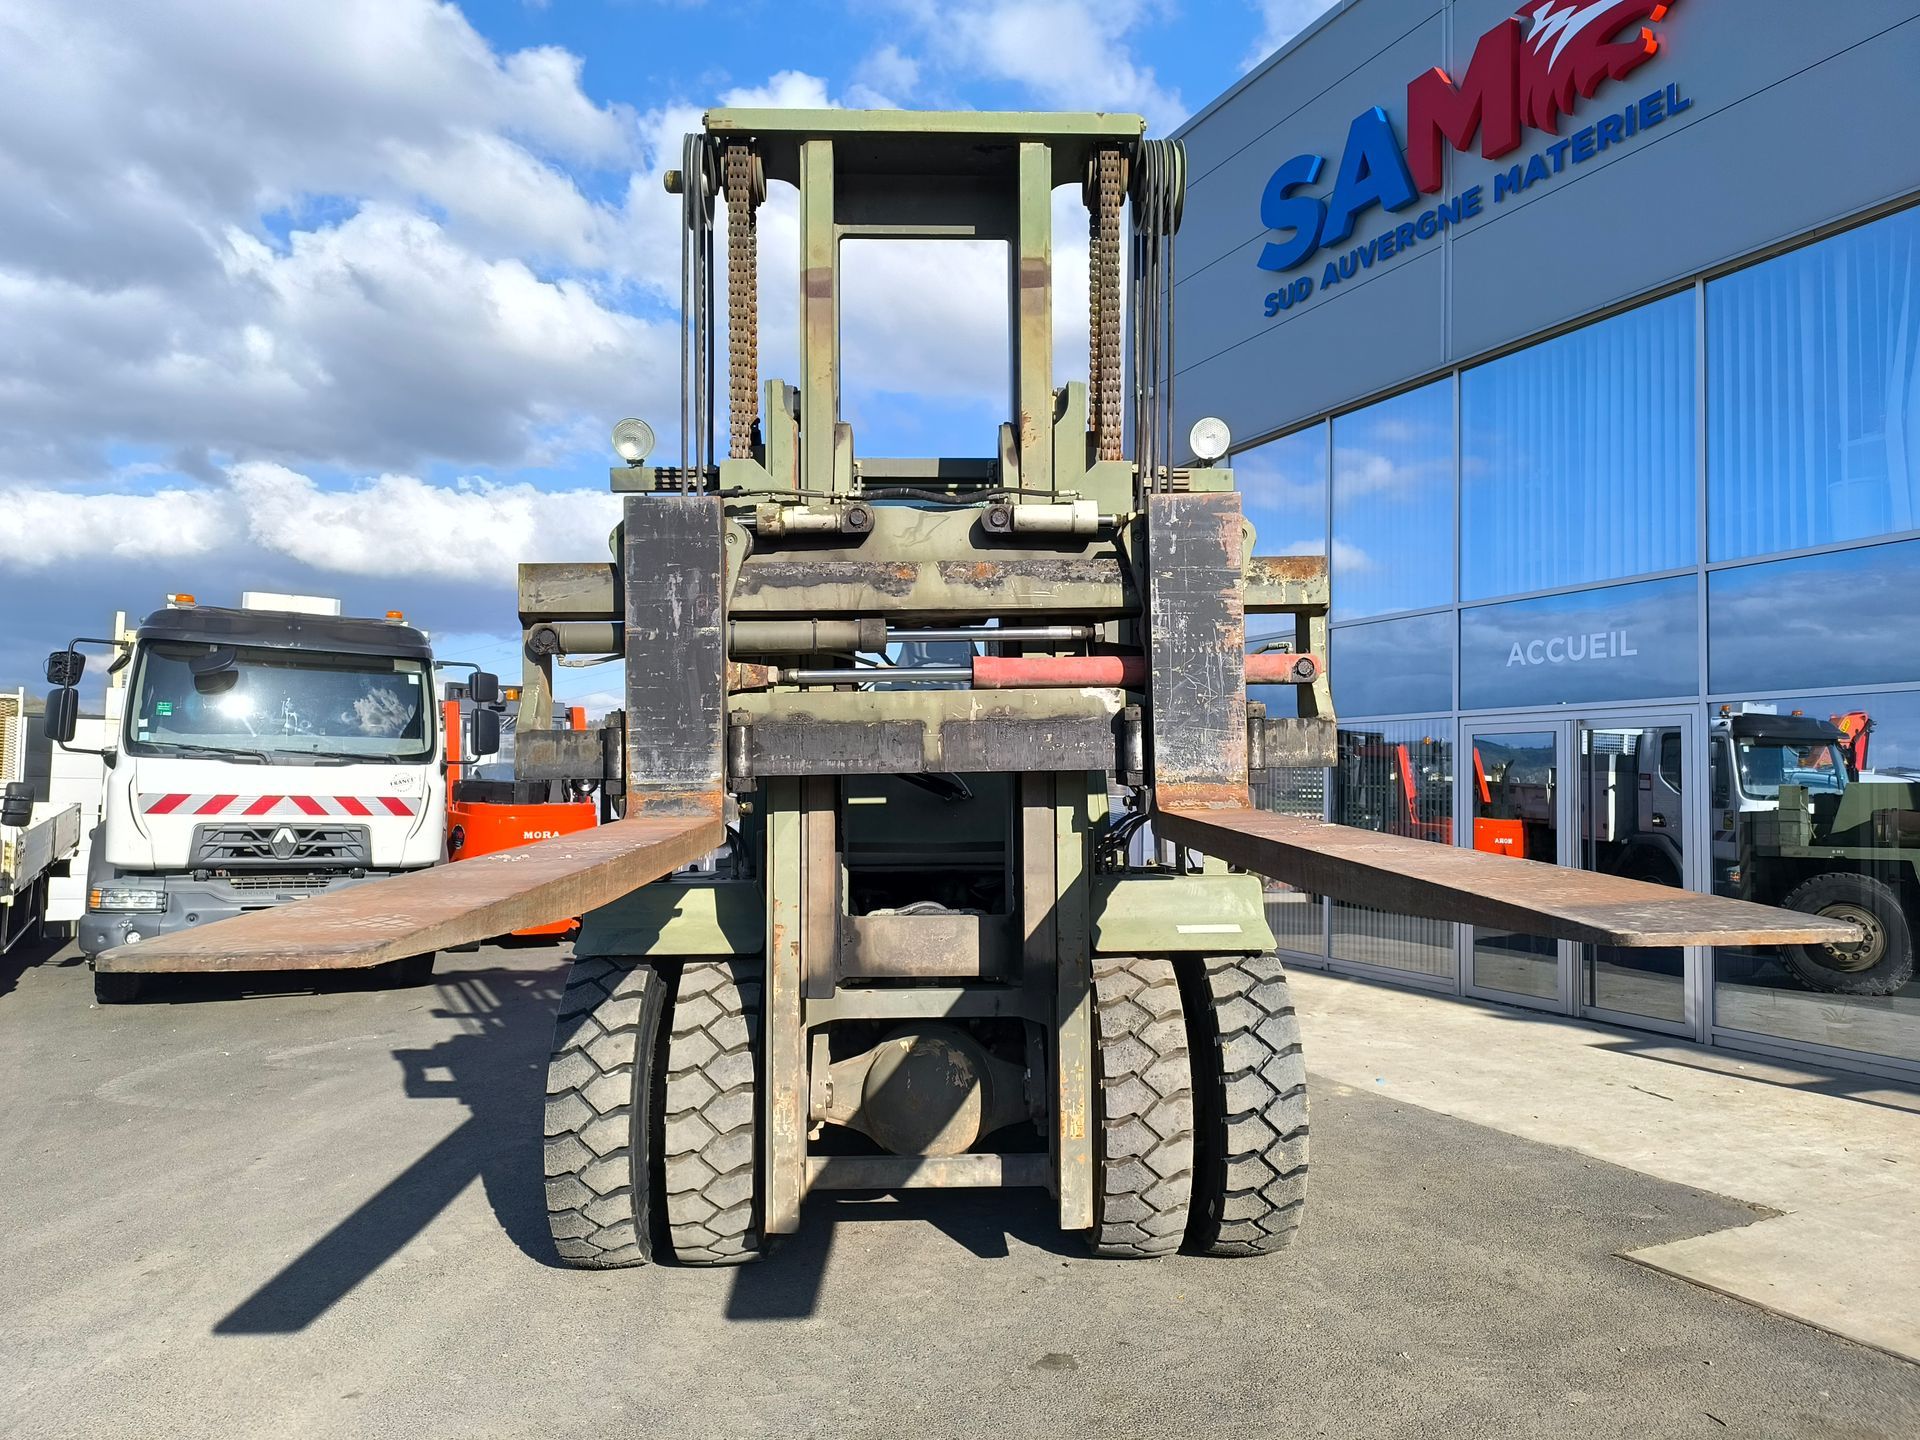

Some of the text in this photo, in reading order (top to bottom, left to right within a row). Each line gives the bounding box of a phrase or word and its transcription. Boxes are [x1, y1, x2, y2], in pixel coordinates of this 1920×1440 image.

[1264, 81, 1692, 318] SUD AUVERGNE MATERIEL
[1506, 630, 1638, 667] ACCUEIL
[523, 831, 560, 839] MORA
